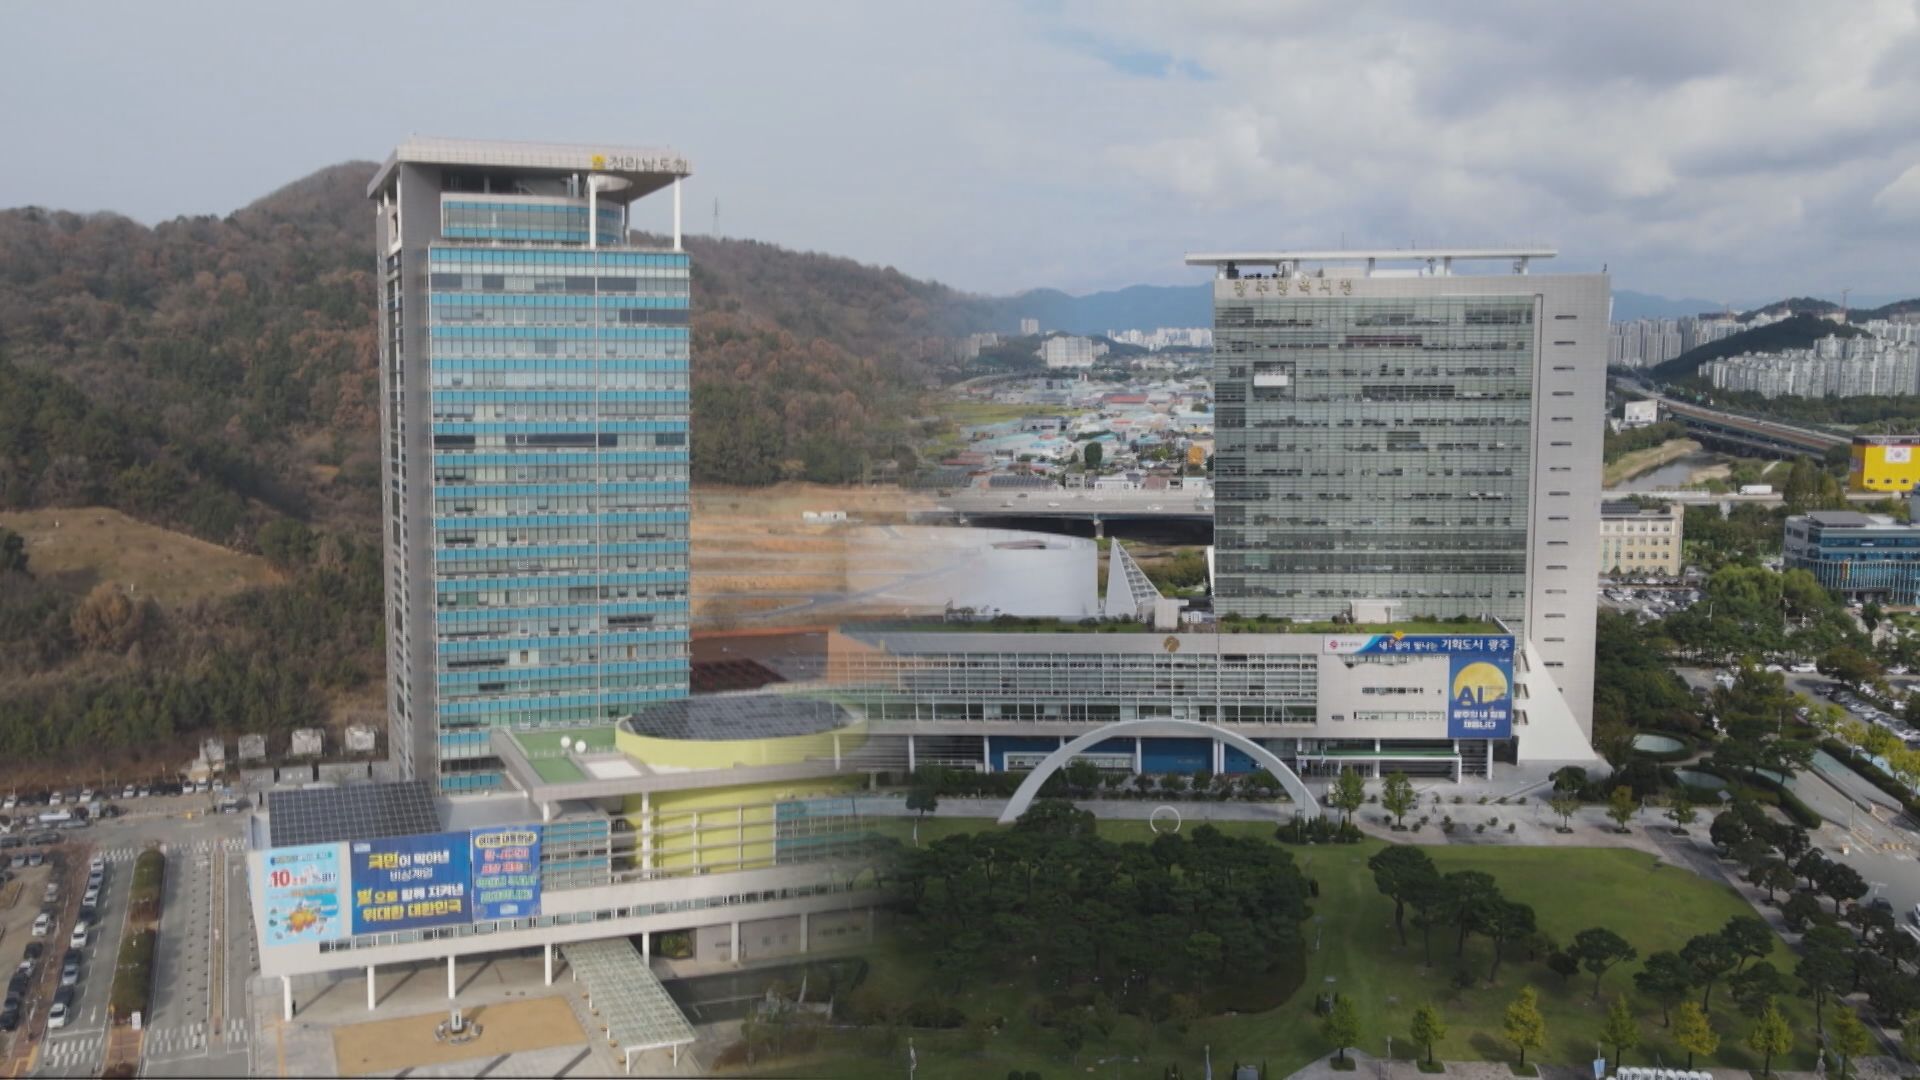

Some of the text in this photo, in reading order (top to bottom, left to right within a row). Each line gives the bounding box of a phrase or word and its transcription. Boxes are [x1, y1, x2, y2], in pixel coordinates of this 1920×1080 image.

[608, 156, 687, 173] 전라남도청
[1442, 639, 1483, 651] 기회도시
[1488, 639, 1510, 652] 광주
[1457, 685, 1483, 704] AI
[363, 899, 462, 922] 위대한 대한민국
